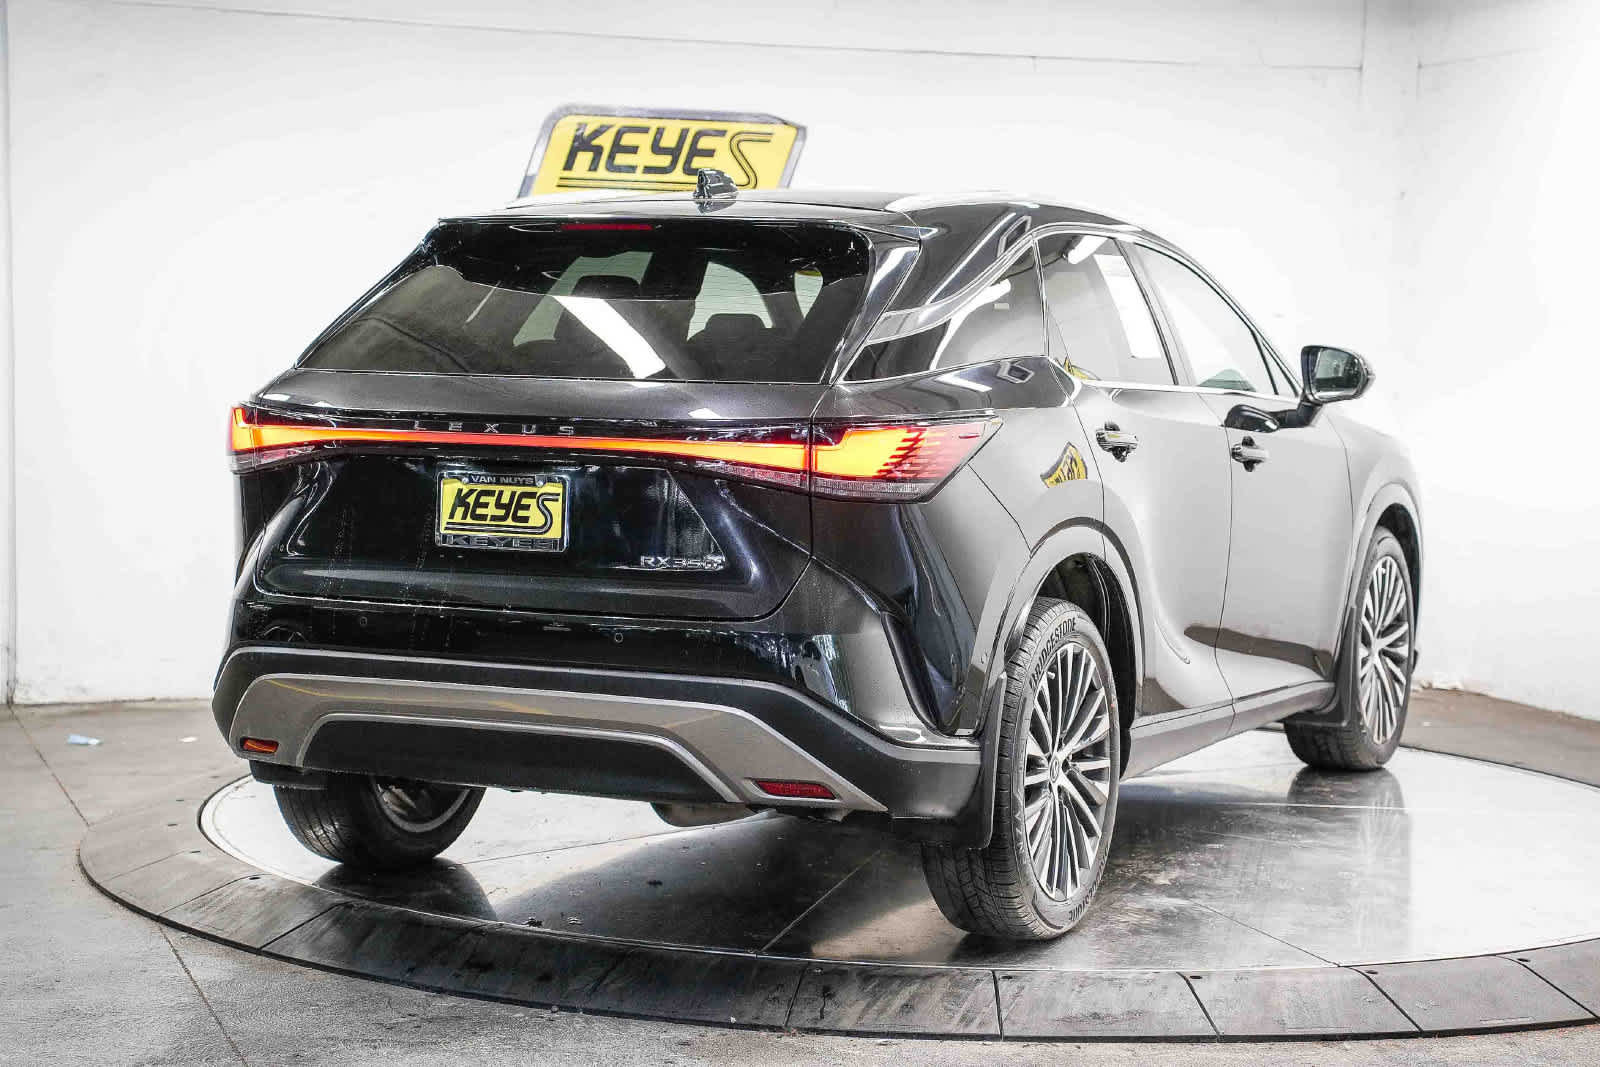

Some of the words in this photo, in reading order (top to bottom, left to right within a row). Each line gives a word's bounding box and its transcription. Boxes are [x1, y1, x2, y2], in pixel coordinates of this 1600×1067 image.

[560, 122, 774, 189] KEYES
[413, 420, 575, 436] LEXUS
[471, 475, 497, 485] VAN
[501, 476, 534, 486] NUYS
[446, 487, 561, 534] KEYES
